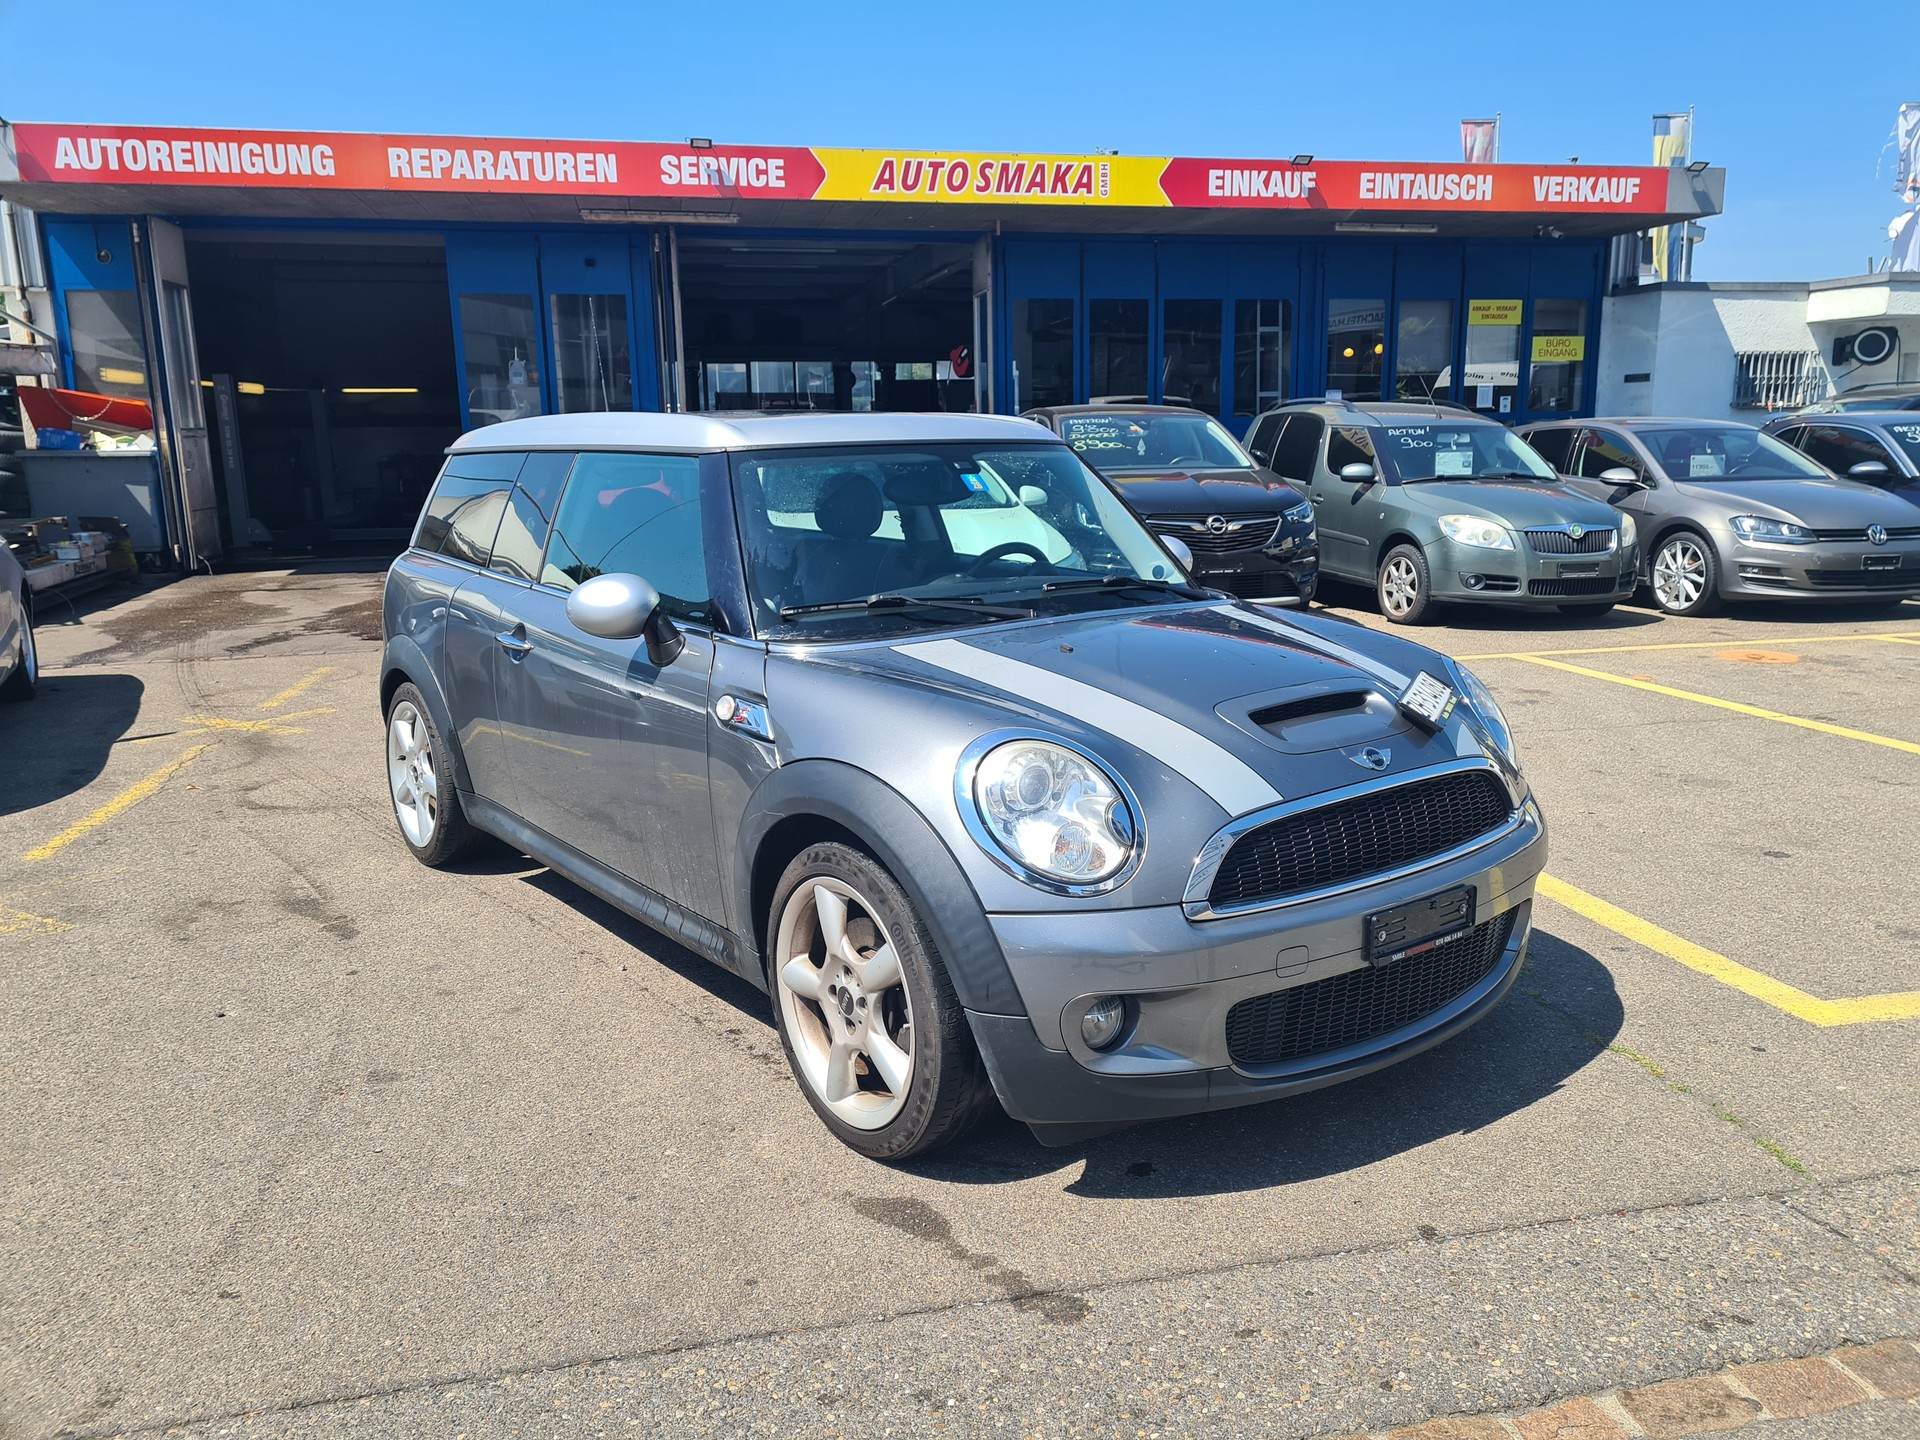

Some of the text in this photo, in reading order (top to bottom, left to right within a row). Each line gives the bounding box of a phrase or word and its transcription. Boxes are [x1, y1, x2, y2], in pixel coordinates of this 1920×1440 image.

[55, 137, 336, 176] AUTOREINIGUNG
[387, 147, 618, 183] REPARATUREN
[659, 155, 786, 187] SERVICE
[871, 159, 1094, 195] AUTO SMAKA
[1100, 162, 1109, 197] GMBH
[1208, 169, 1317, 199] EINKAUF
[1359, 172, 1493, 201] EINTAUSCH
[1533, 175, 1641, 204] VERKAUF
[1538, 348, 1577, 357] EINGANG
[1546, 338, 1571, 348] BÜRO
[1388, 426, 1431, 436] AKTION!
[1391, 951, 1406, 962] SMILE
